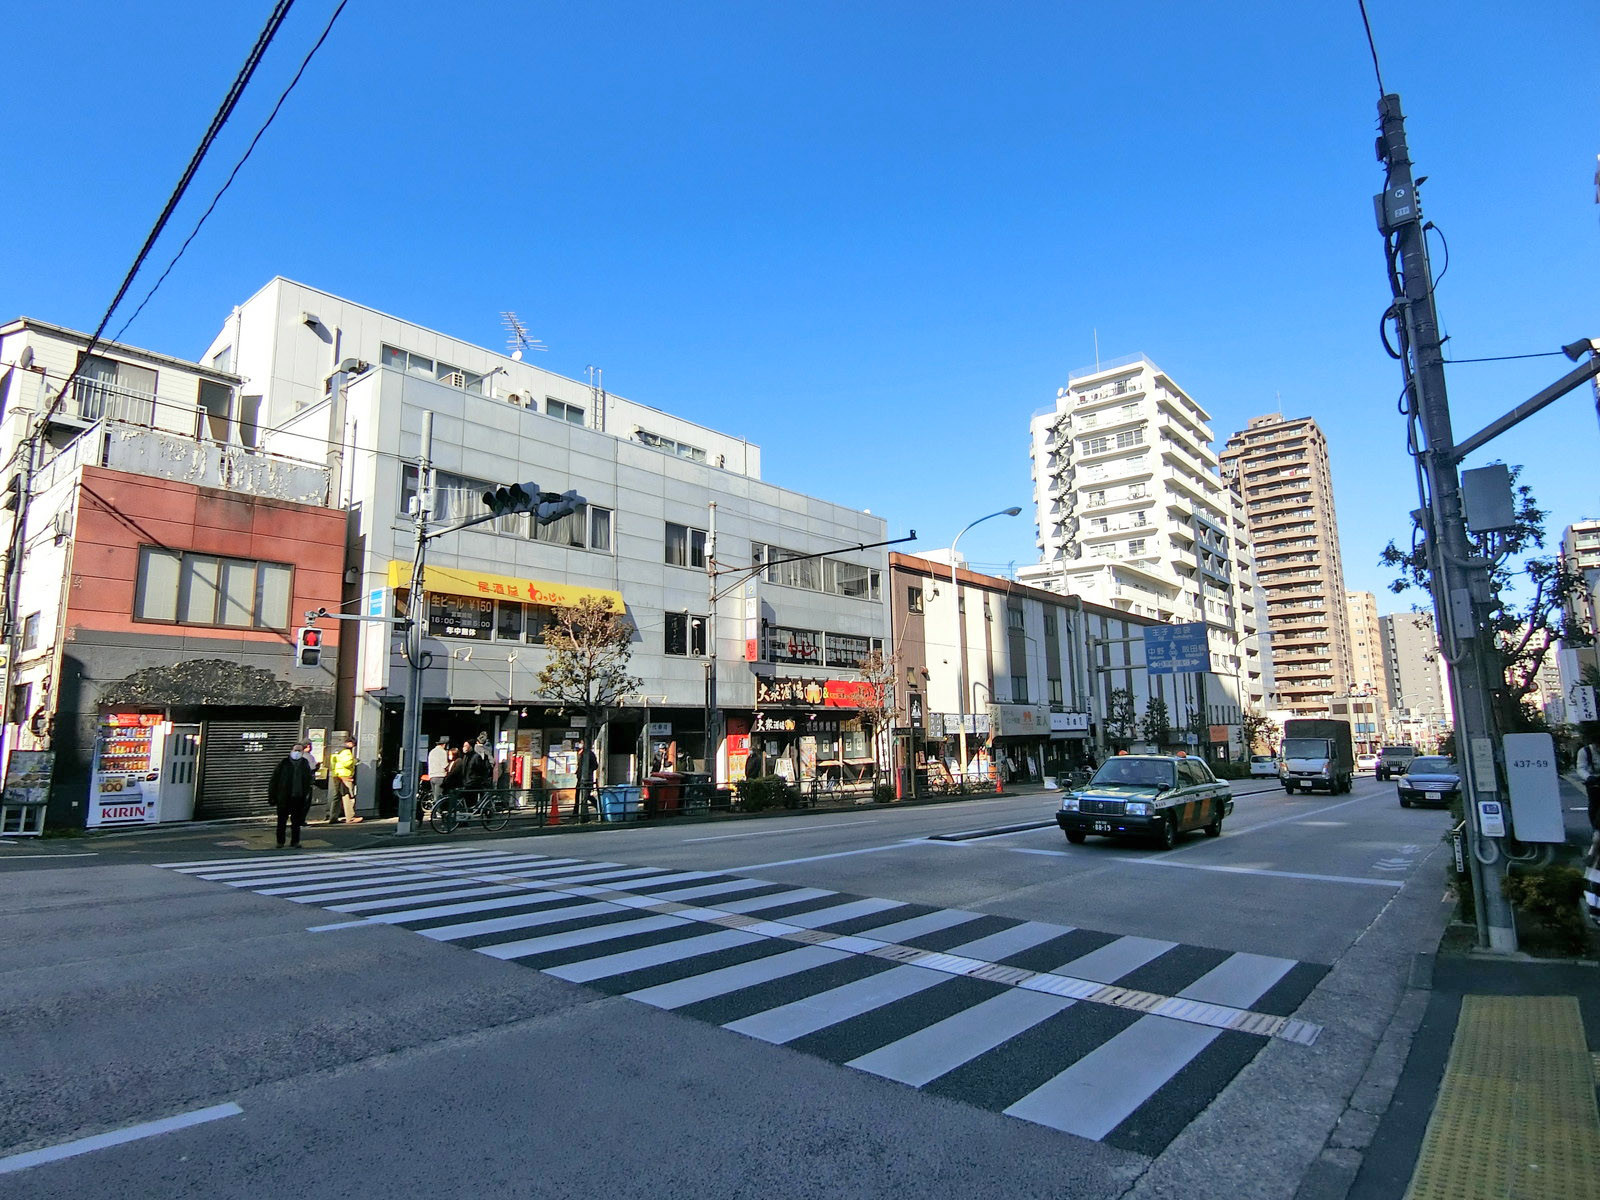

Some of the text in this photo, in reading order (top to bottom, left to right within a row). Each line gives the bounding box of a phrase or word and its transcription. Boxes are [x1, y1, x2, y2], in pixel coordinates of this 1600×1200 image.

[478, 581, 519, 597] 居酒屋
[431, 594, 464, 609] 生ビール
[1152, 628, 1168, 636] 王子
[1148, 647, 1165, 655] 中野
[757, 680, 804, 702] 大衆酒場
[756, 717, 785, 731] 大衆酒場
[102, 806, 145, 818] KIRIN
